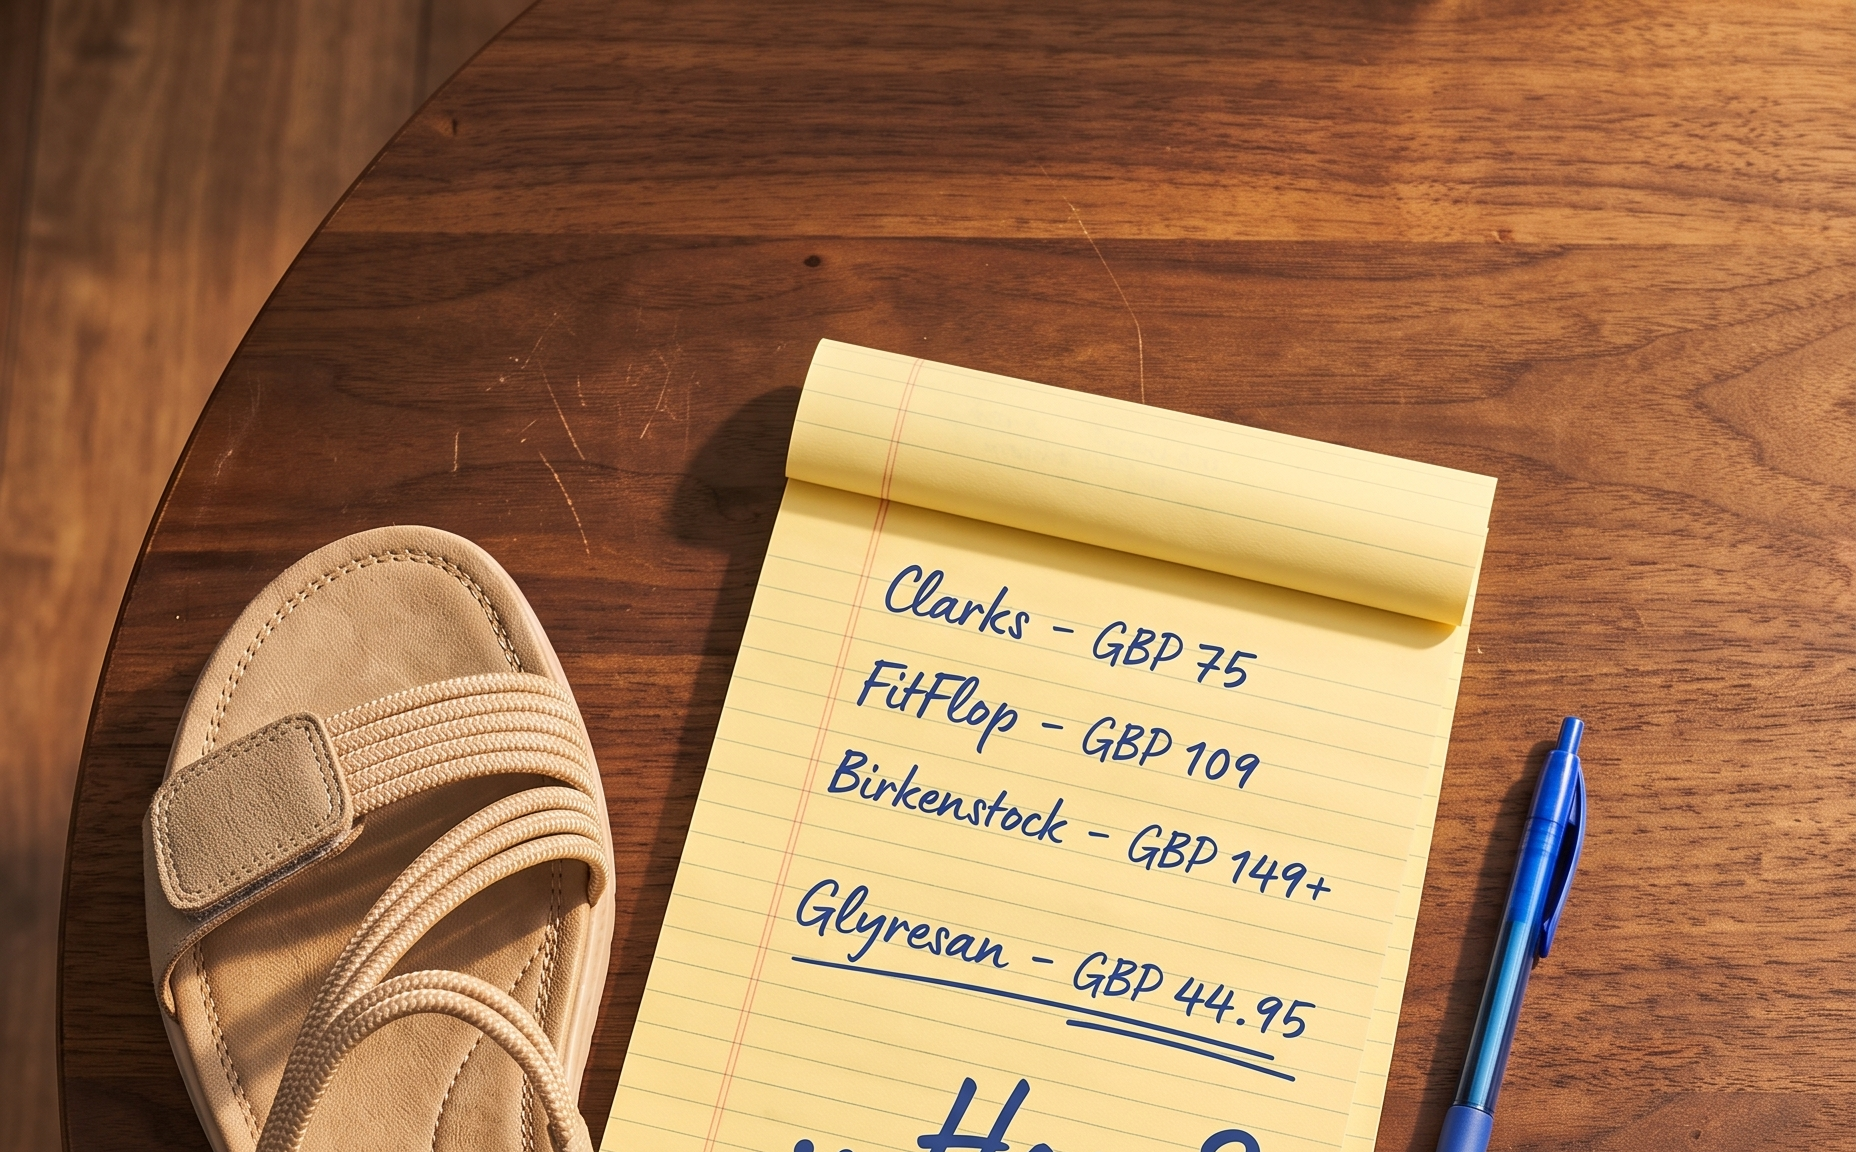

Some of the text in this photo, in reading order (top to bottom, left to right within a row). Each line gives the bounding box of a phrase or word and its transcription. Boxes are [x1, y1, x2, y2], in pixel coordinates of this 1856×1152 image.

[884, 564, 1030, 640] Clarks
[1092, 620, 1184, 671] GBP
[1196, 643, 1258, 689] 75
[856, 659, 1019, 754] FitFlop
[1081, 716, 1173, 766] GBP
[1186, 741, 1261, 789] 109
[827, 748, 1068, 844] Birkenstock
[1127, 823, 1219, 873] GBP
[1231, 850, 1331, 900] 149+
[795, 878, 1007, 969] Glyresan
[1072, 951, 1164, 1001] GBP
[1173, 977, 1316, 1039] 44.95
